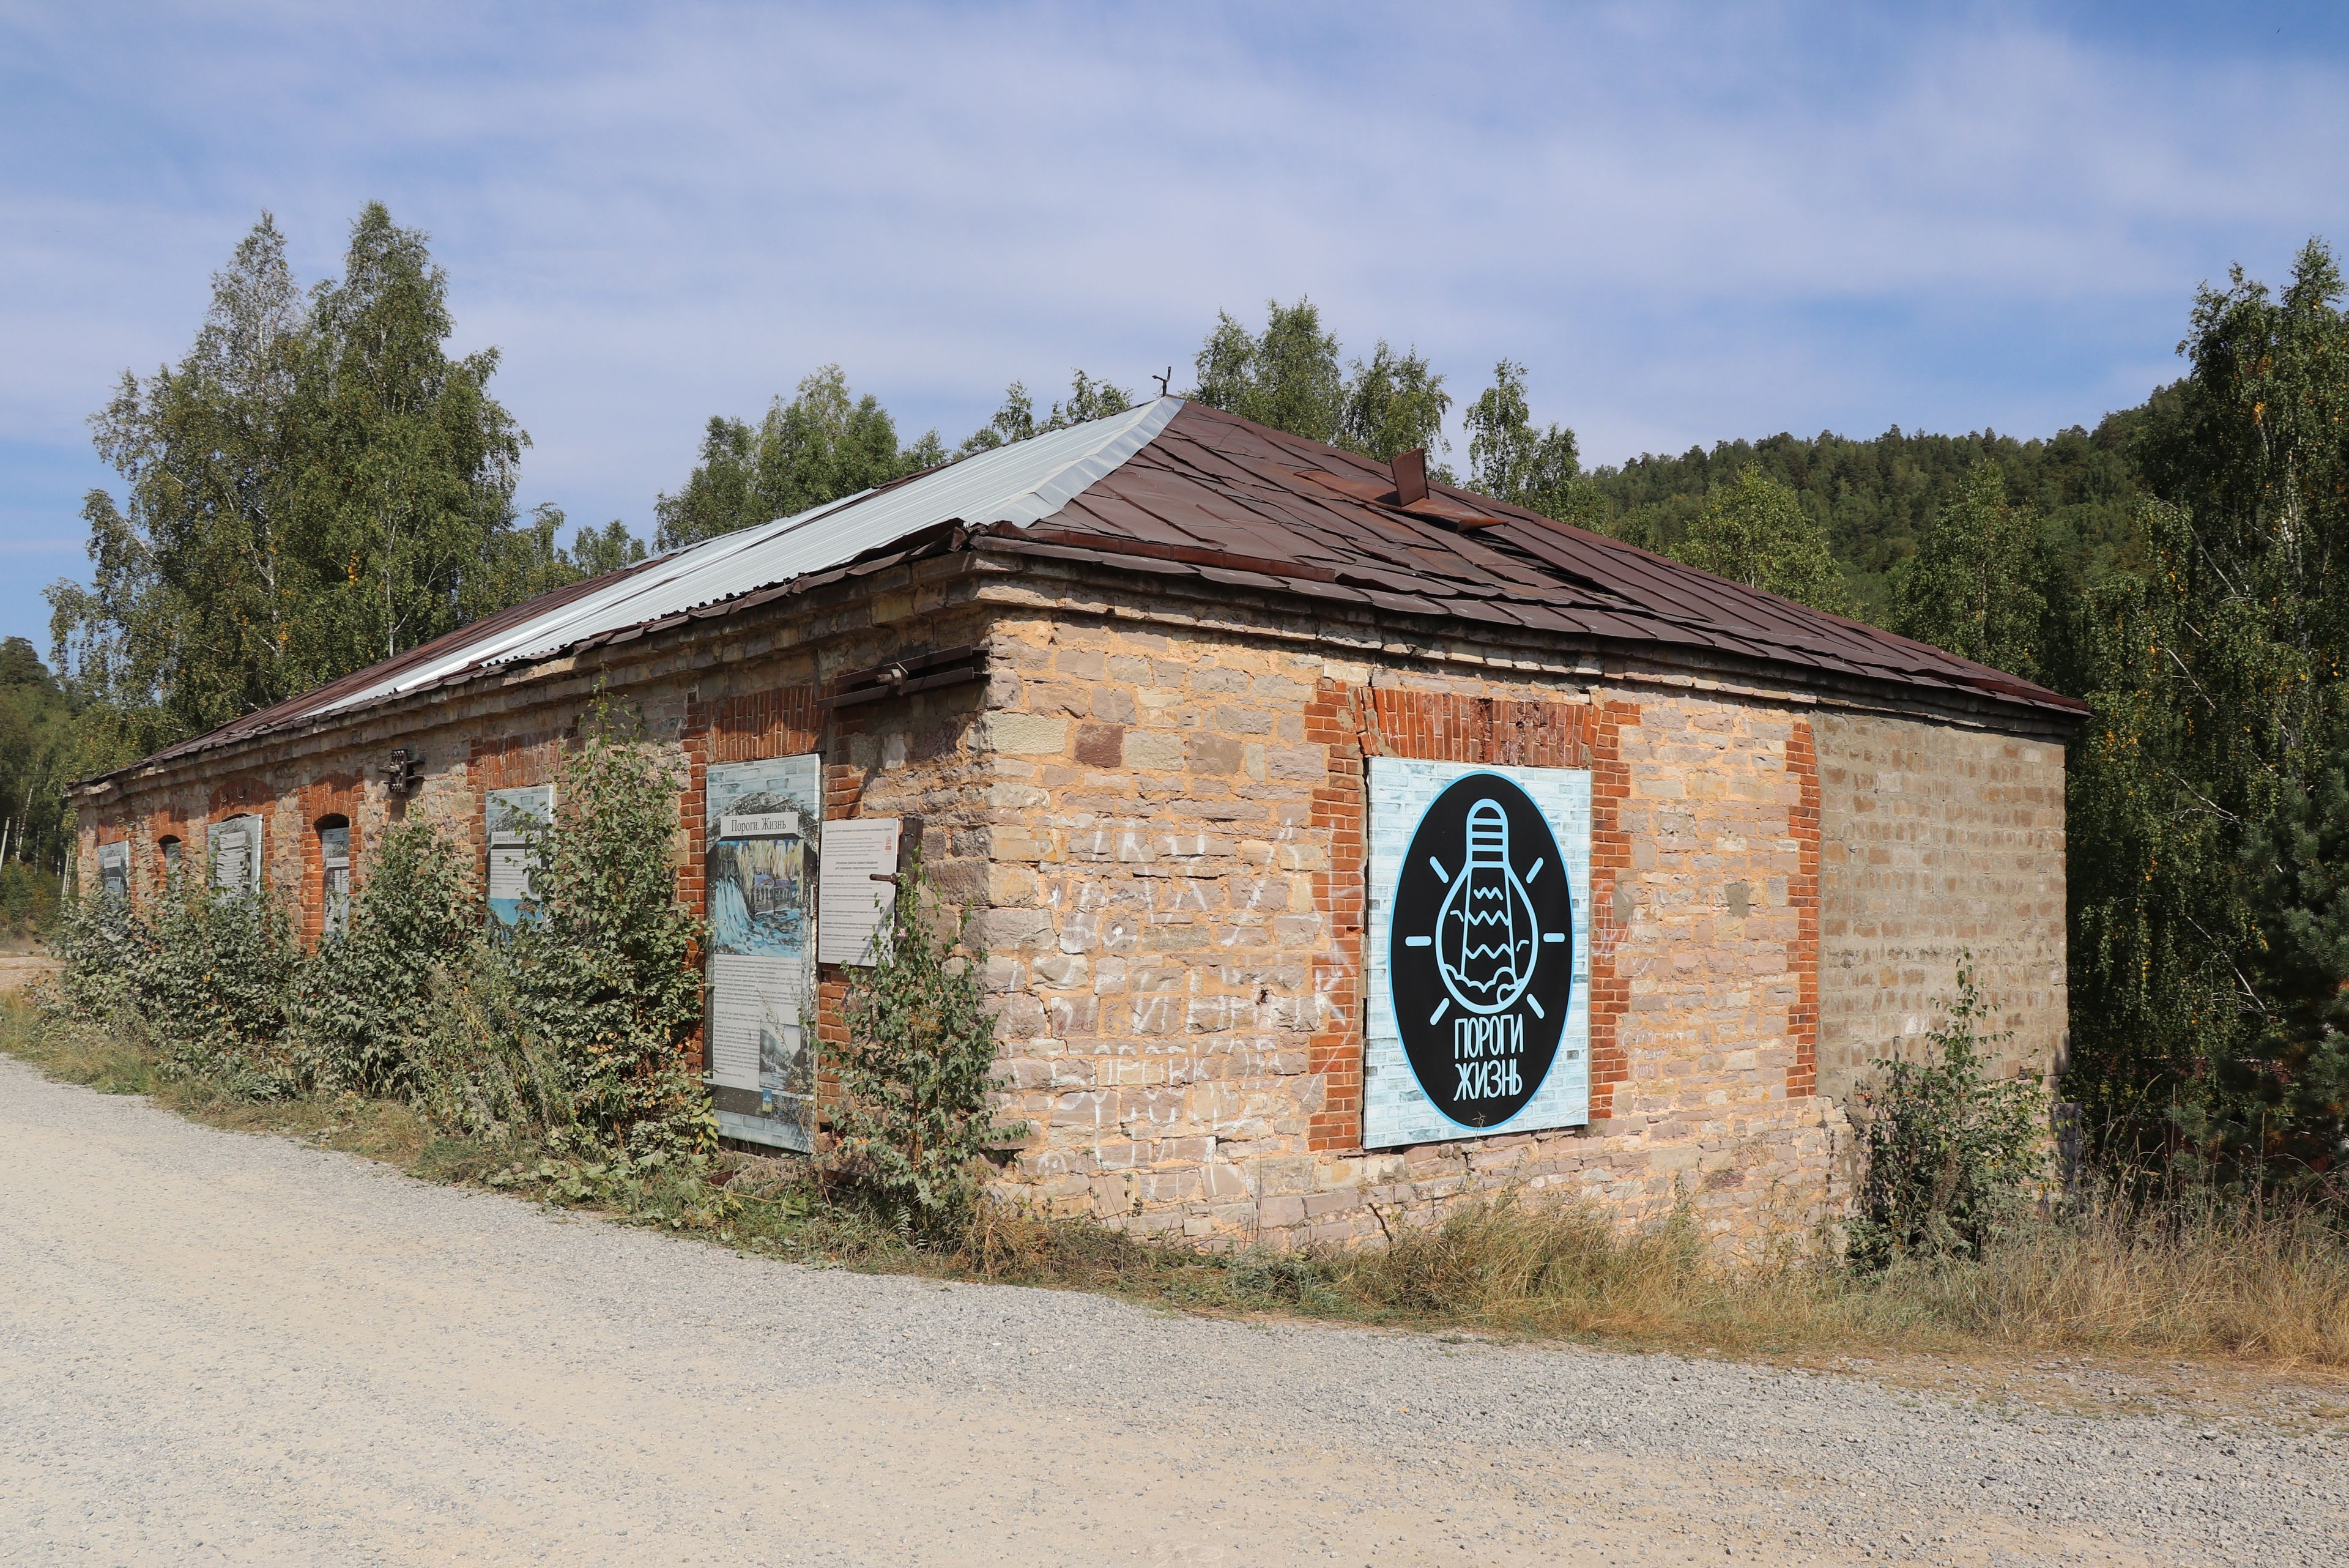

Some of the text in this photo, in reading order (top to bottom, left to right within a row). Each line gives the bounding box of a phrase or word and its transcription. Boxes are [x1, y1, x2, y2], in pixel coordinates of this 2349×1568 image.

[731, 817, 786, 834] Пороги. Жизнь
[1455, 1013, 1524, 1059] ПОРОГИ
[1453, 1058, 1523, 1101] ЖИЗНЬ
[1635, 1064, 1655, 1078] 2019
